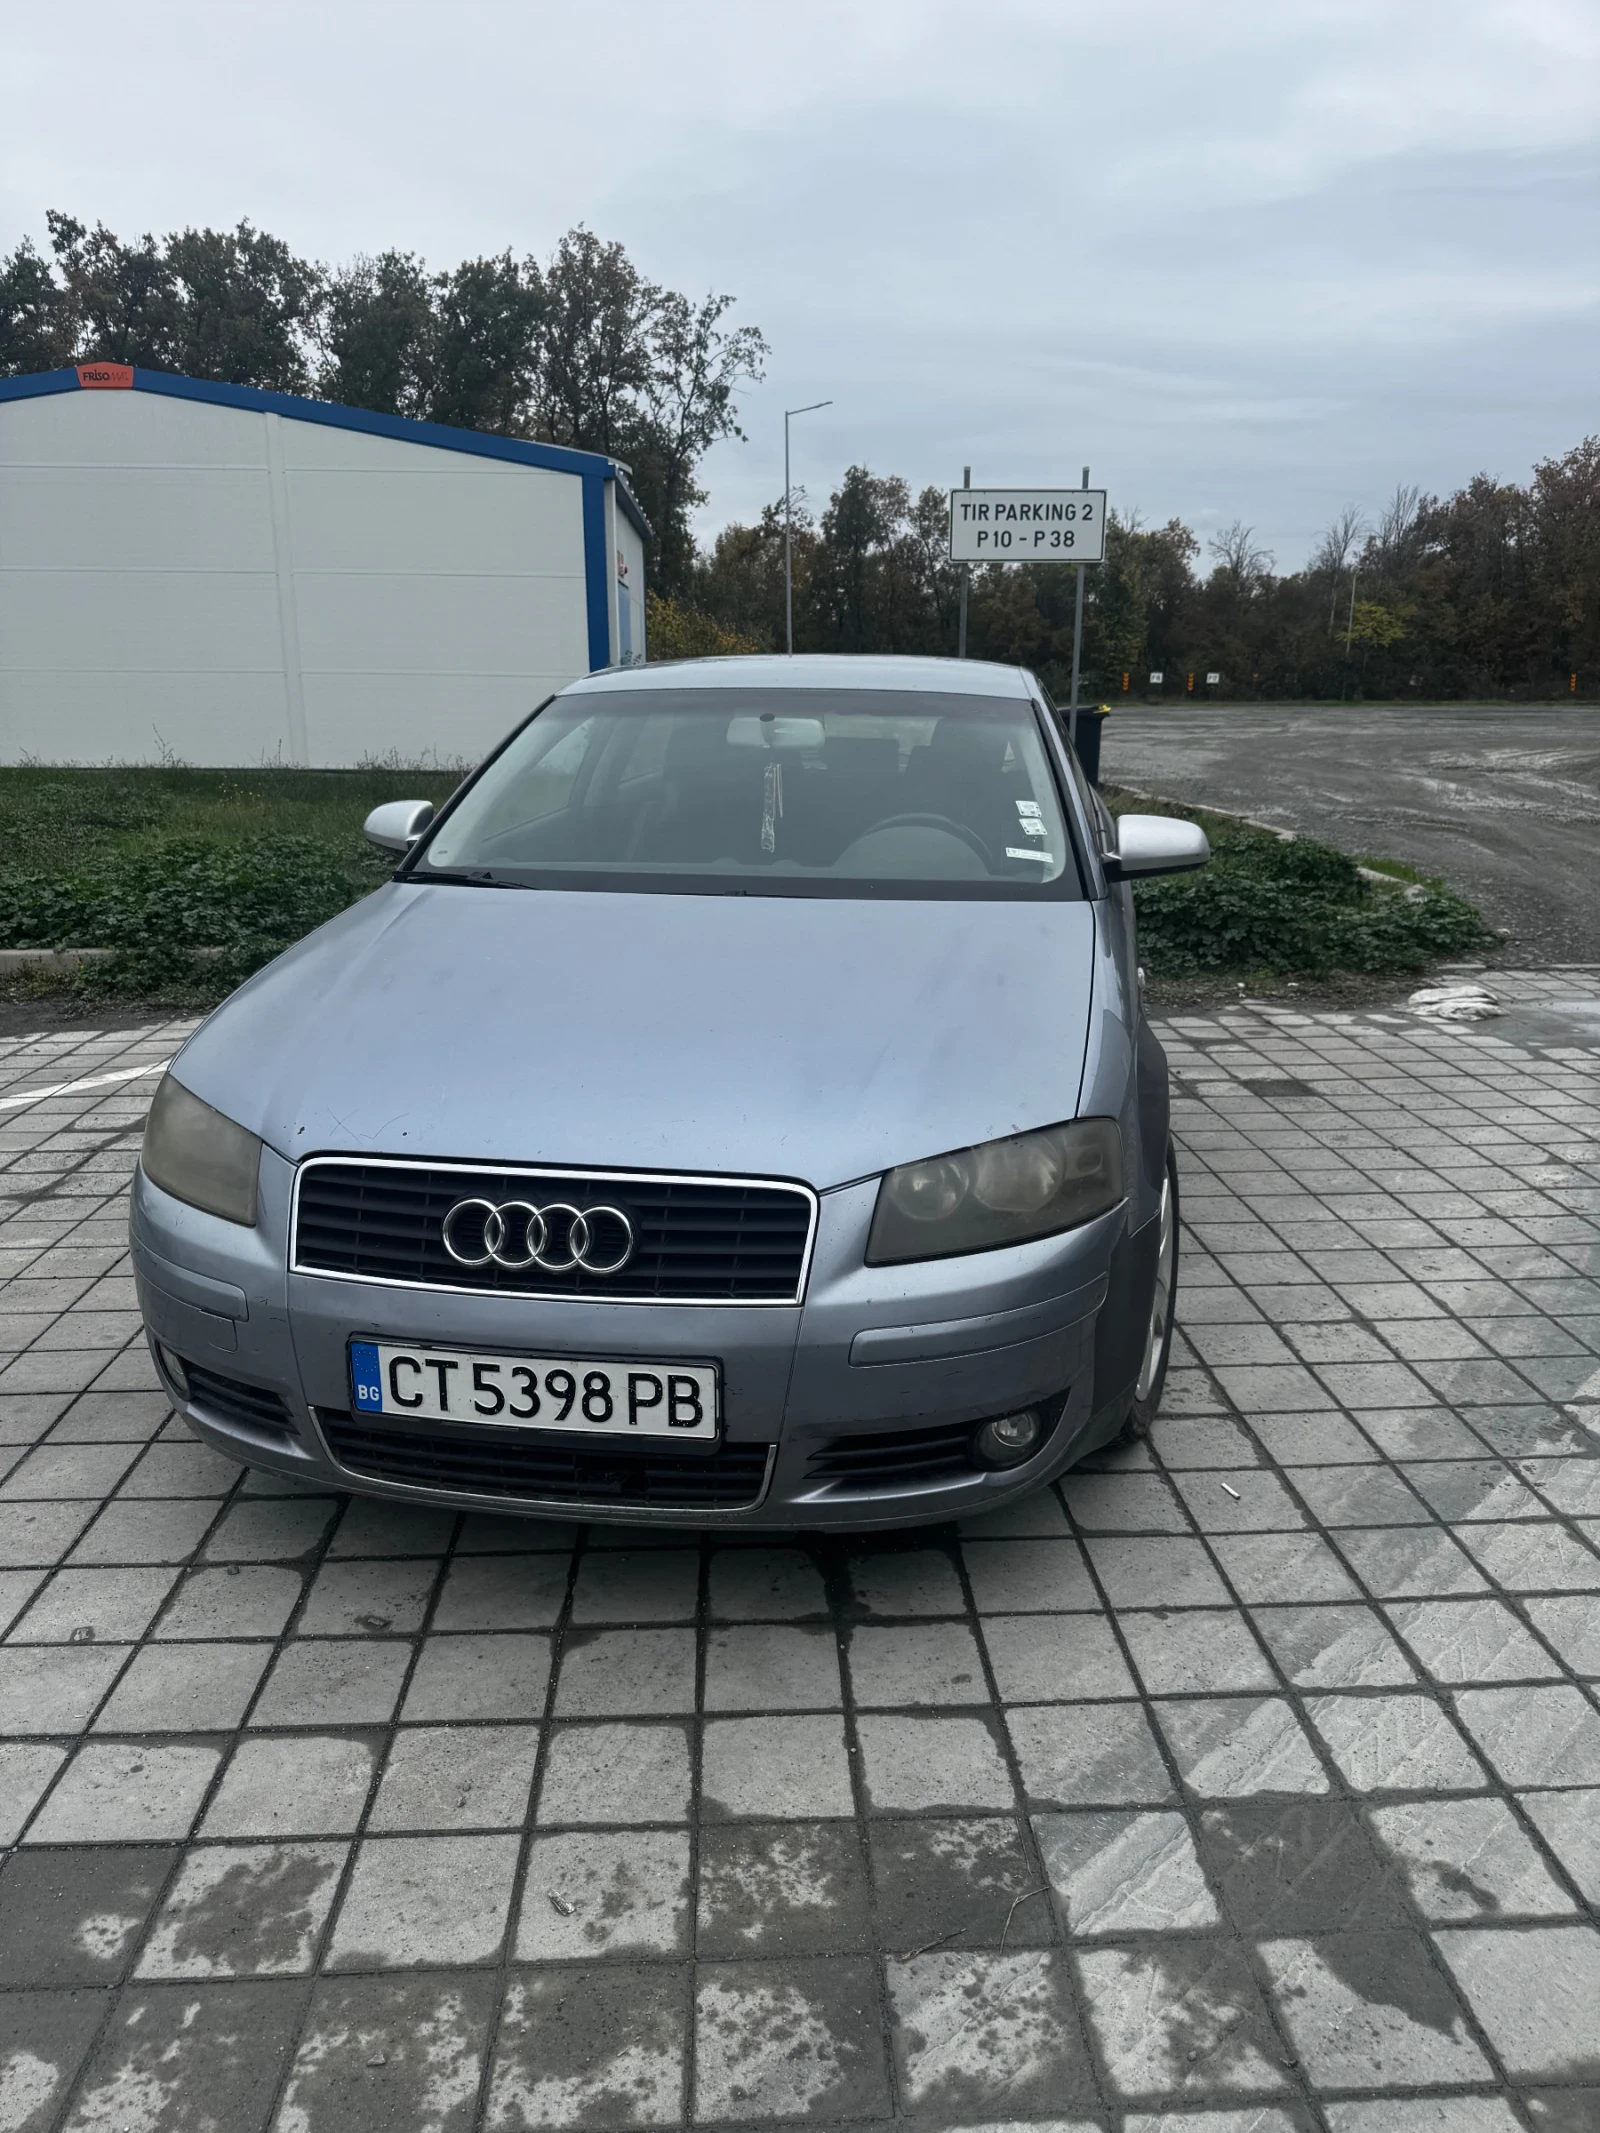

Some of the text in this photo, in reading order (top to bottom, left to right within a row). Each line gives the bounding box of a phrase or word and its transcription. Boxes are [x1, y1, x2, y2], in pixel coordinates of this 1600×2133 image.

[960, 503, 1093, 521] TIR PARKING 2
[357, 1384, 381, 1401] BG
[388, 1354, 704, 1428] CT 5398 PB
